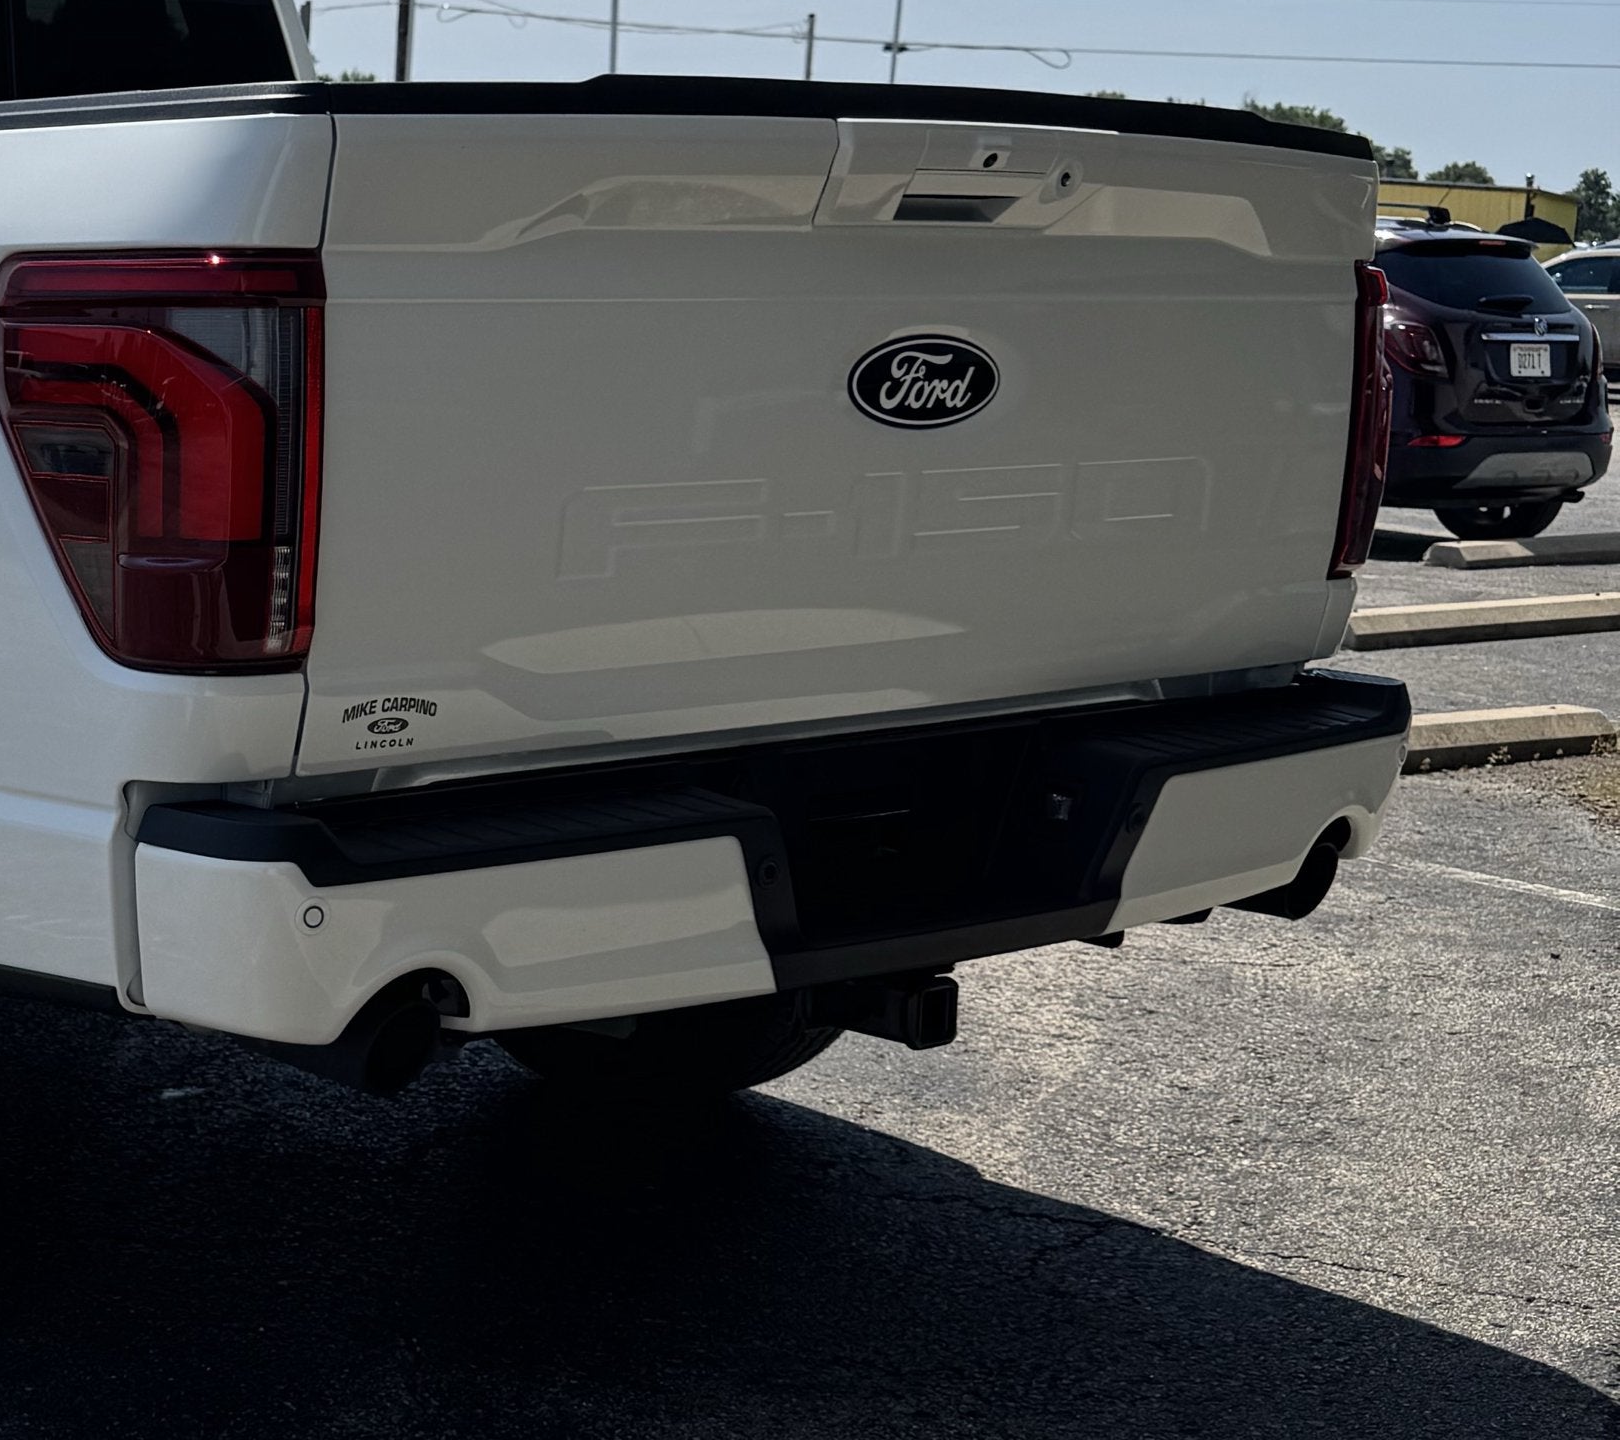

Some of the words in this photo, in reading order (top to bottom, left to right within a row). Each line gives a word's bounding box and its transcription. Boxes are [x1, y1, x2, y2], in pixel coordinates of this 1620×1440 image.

[879, 351, 976, 410] Ford
[554, 456, 1213, 581] F-150
[342, 699, 378, 724] MIKE
[381, 697, 438, 717] CARPINO
[355, 737, 414, 750] LINCOLN
